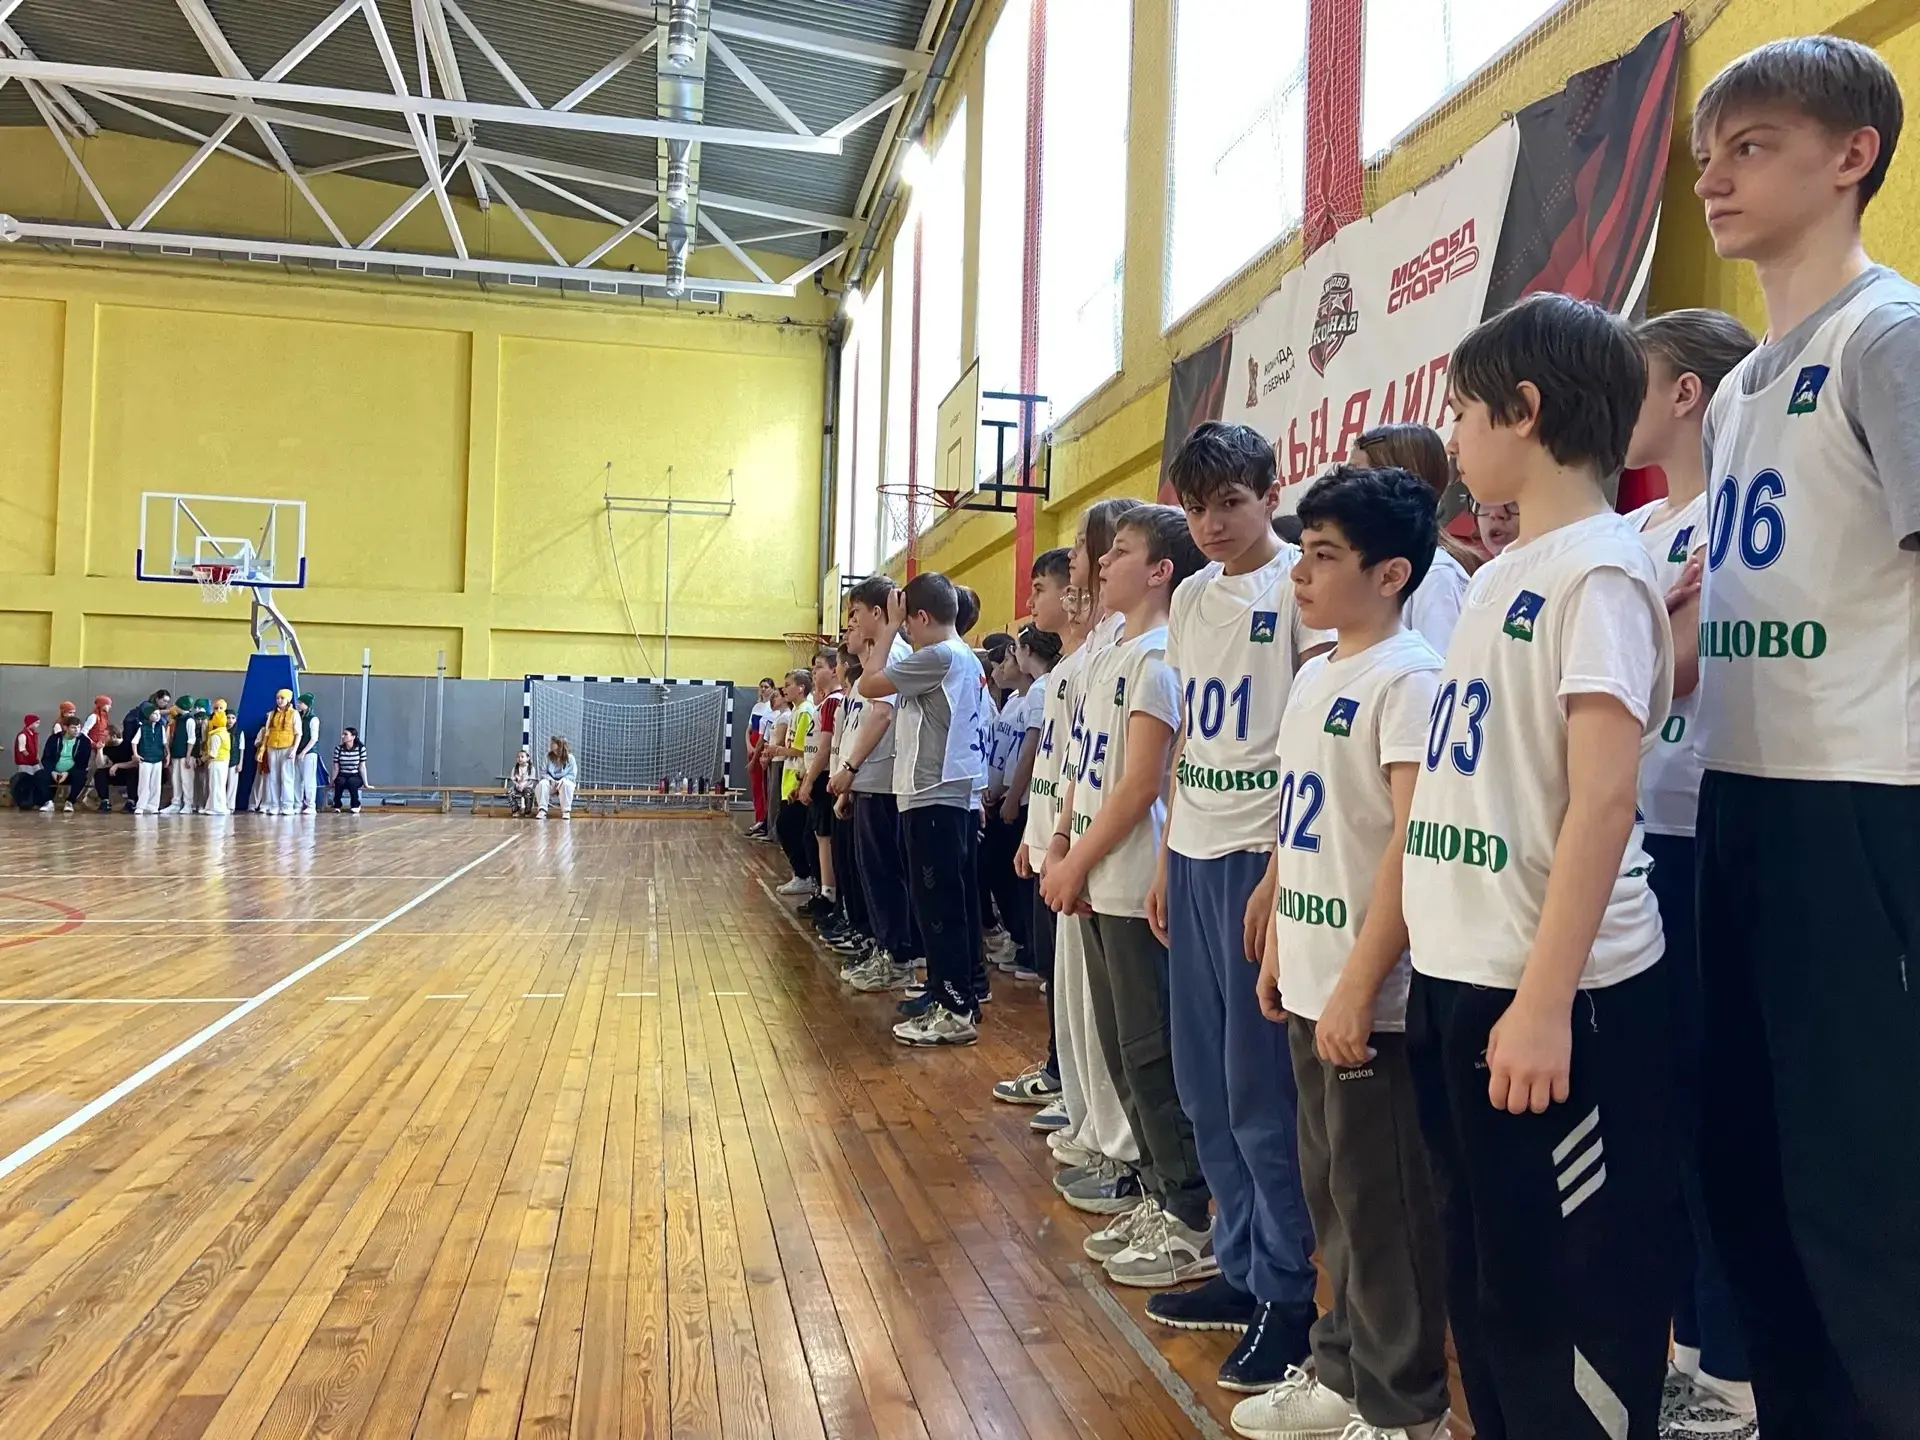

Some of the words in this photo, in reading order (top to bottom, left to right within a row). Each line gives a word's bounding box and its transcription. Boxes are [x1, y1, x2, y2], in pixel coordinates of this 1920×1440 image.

[1387, 257, 1455, 315] СПОРТ
[1390, 217, 1475, 291] МОСОБЛ
[1184, 675, 1252, 742] 101
[1426, 677, 1492, 777] 03
[1338, 1068, 1375, 1081] adidas
